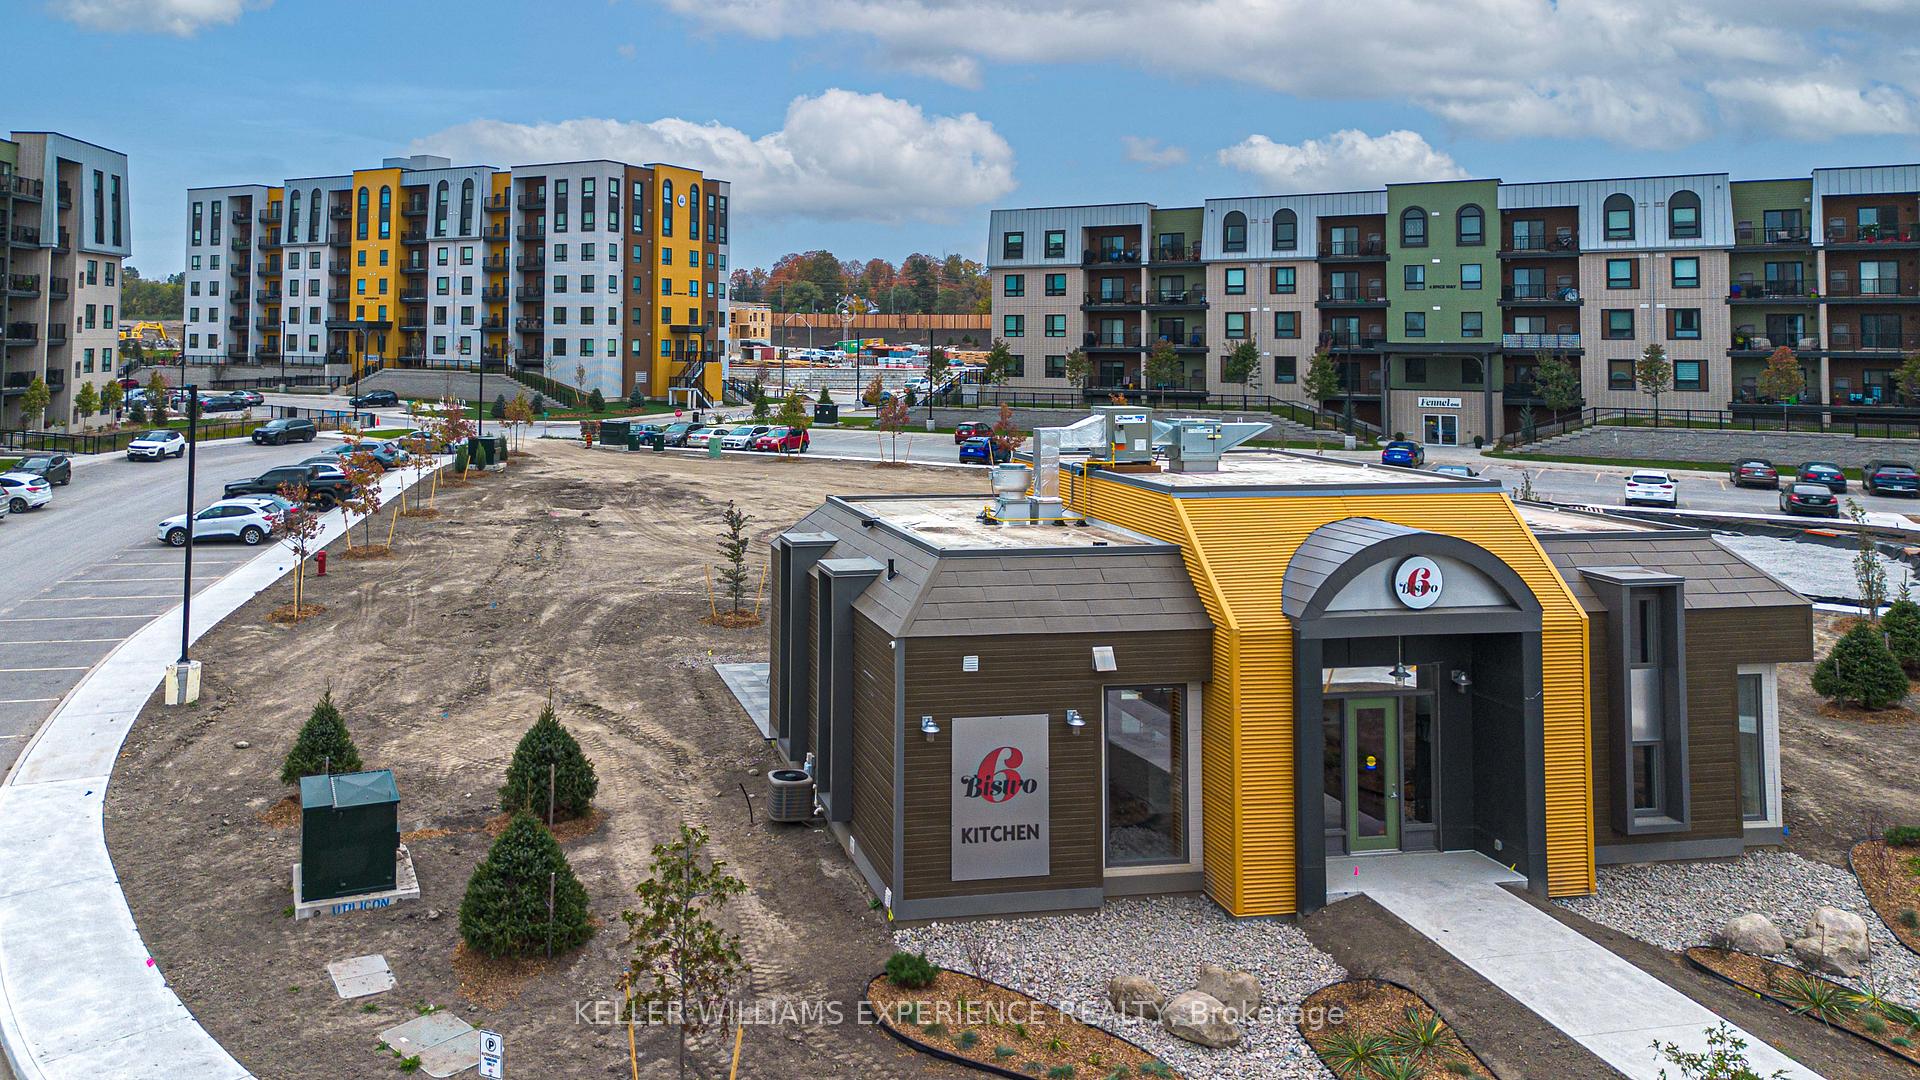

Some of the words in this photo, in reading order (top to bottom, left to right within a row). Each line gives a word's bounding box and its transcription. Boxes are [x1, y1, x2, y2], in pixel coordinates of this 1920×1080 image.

[1421, 398, 1450, 406] Fennel
[1408, 567, 1431, 597] 6
[961, 774, 1038, 798] Bistro
[978, 746, 1024, 803] 6
[961, 824, 1039, 844] KITCHEN
